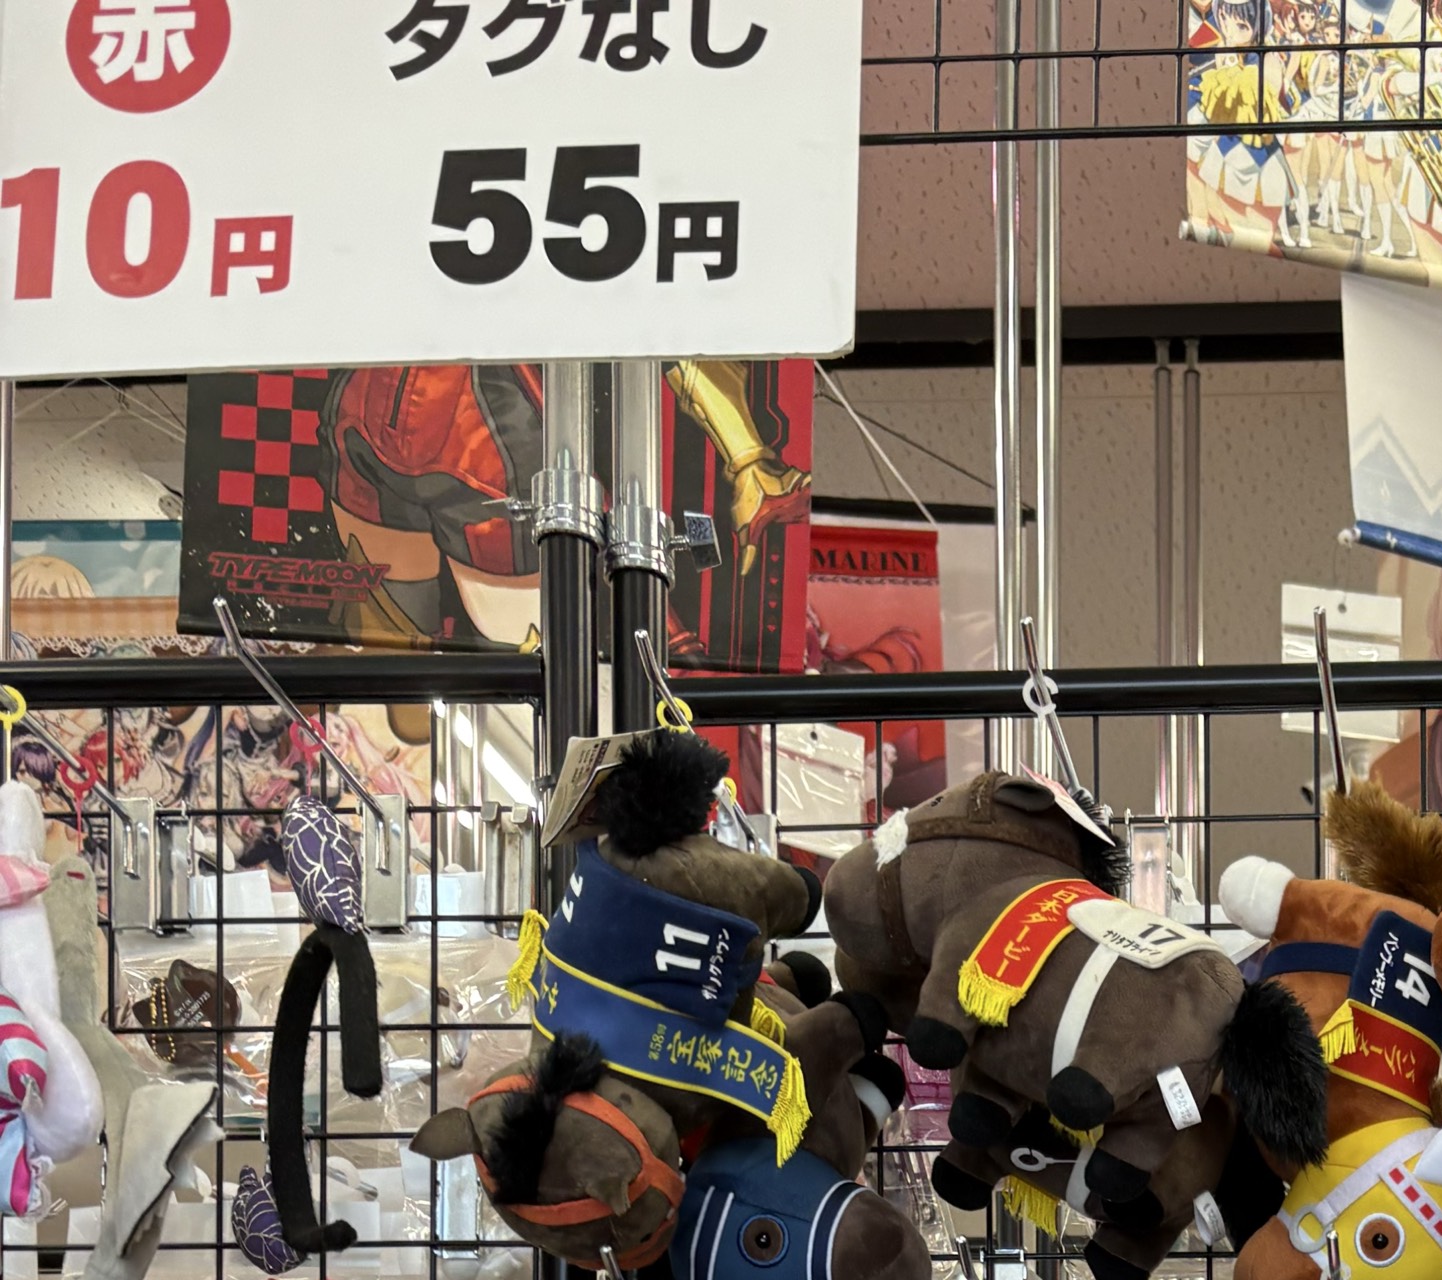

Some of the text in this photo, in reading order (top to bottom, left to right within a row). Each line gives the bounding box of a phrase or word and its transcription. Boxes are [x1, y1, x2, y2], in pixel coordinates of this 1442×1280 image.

[385, 0, 768, 80] タグなし
[429, 144, 741, 285] 55円
[813, 548, 928, 572] MARINE
[656, 923, 710, 972] 11
[997, 889, 1080, 978] 日本ダービー
[1102, 929, 1163, 957] ナリタブライアン
[1138, 922, 1186, 946] 17
[1394, 952, 1437, 1007] 14
[667, 1030, 778, 1099] 宝塚記念
